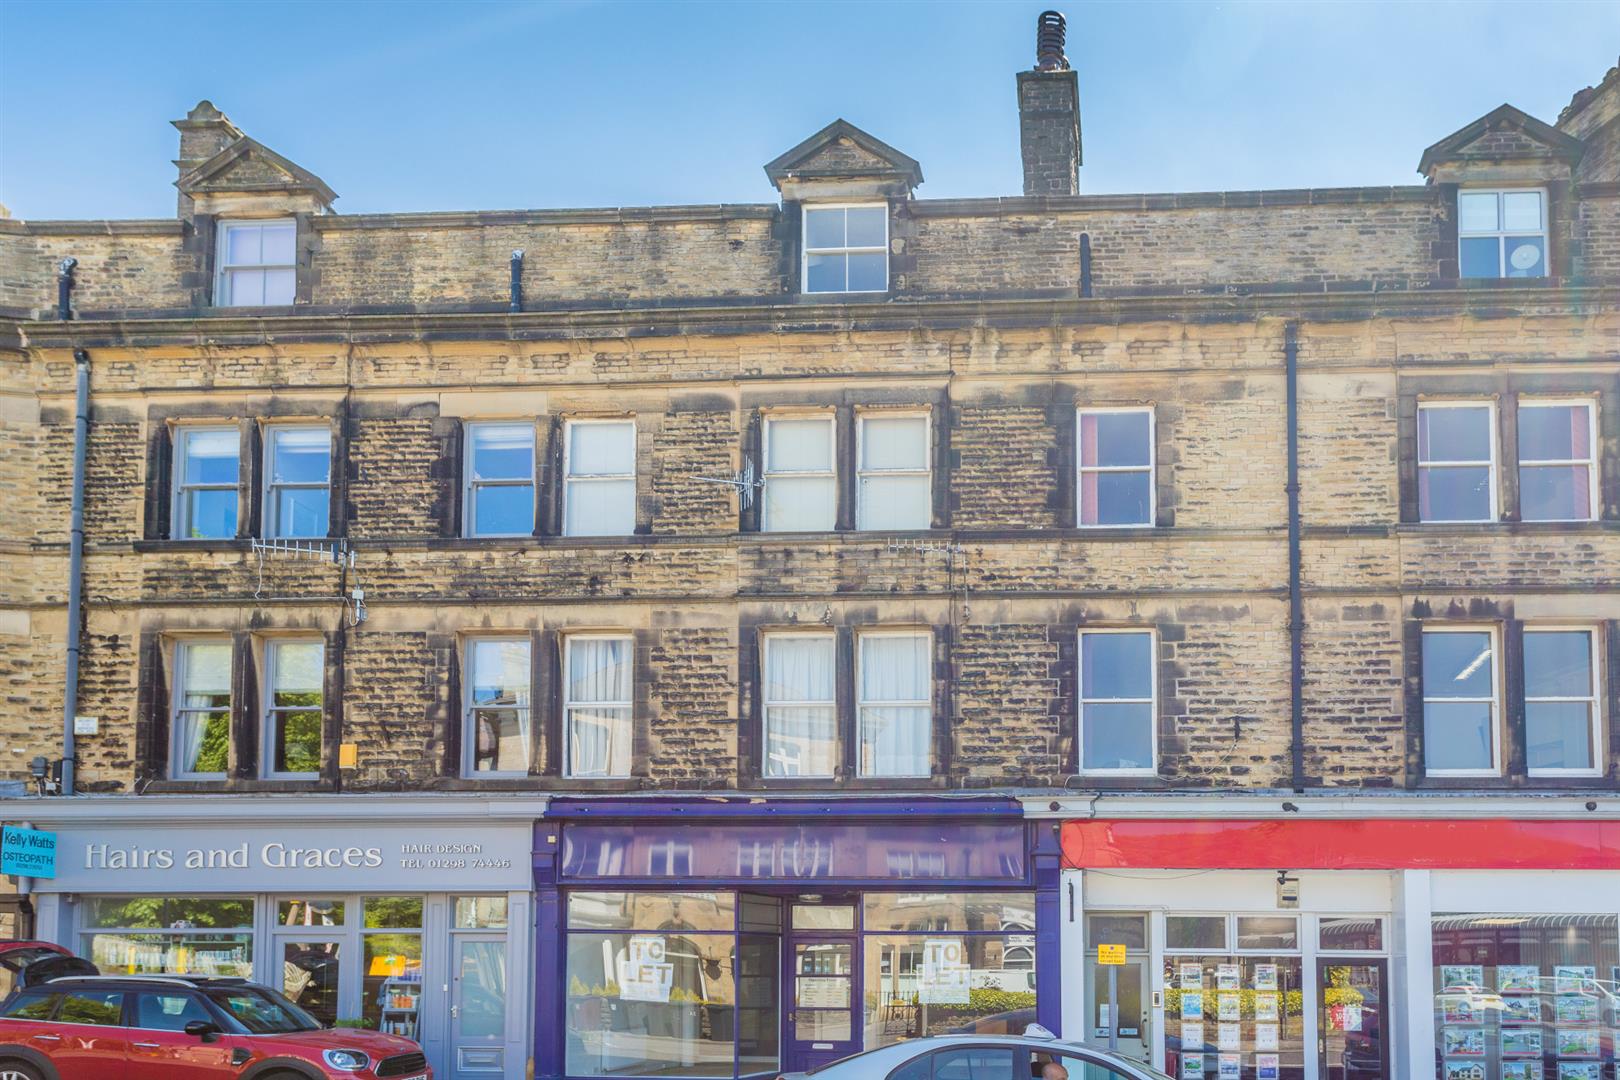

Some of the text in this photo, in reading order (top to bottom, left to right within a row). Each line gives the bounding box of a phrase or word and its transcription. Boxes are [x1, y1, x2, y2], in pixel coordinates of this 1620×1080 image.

[4, 831, 55, 849] Kelly Watts
[401, 844, 482, 854] HAIR DESIGN
[3, 851, 54, 865] OSTEOPATH
[84, 842, 383, 869] Hairs and Graces
[428, 859, 466, 869] 01298
[472, 859, 511, 869] 74446
[631, 941, 664, 960] TO
[926, 943, 961, 962] TO
